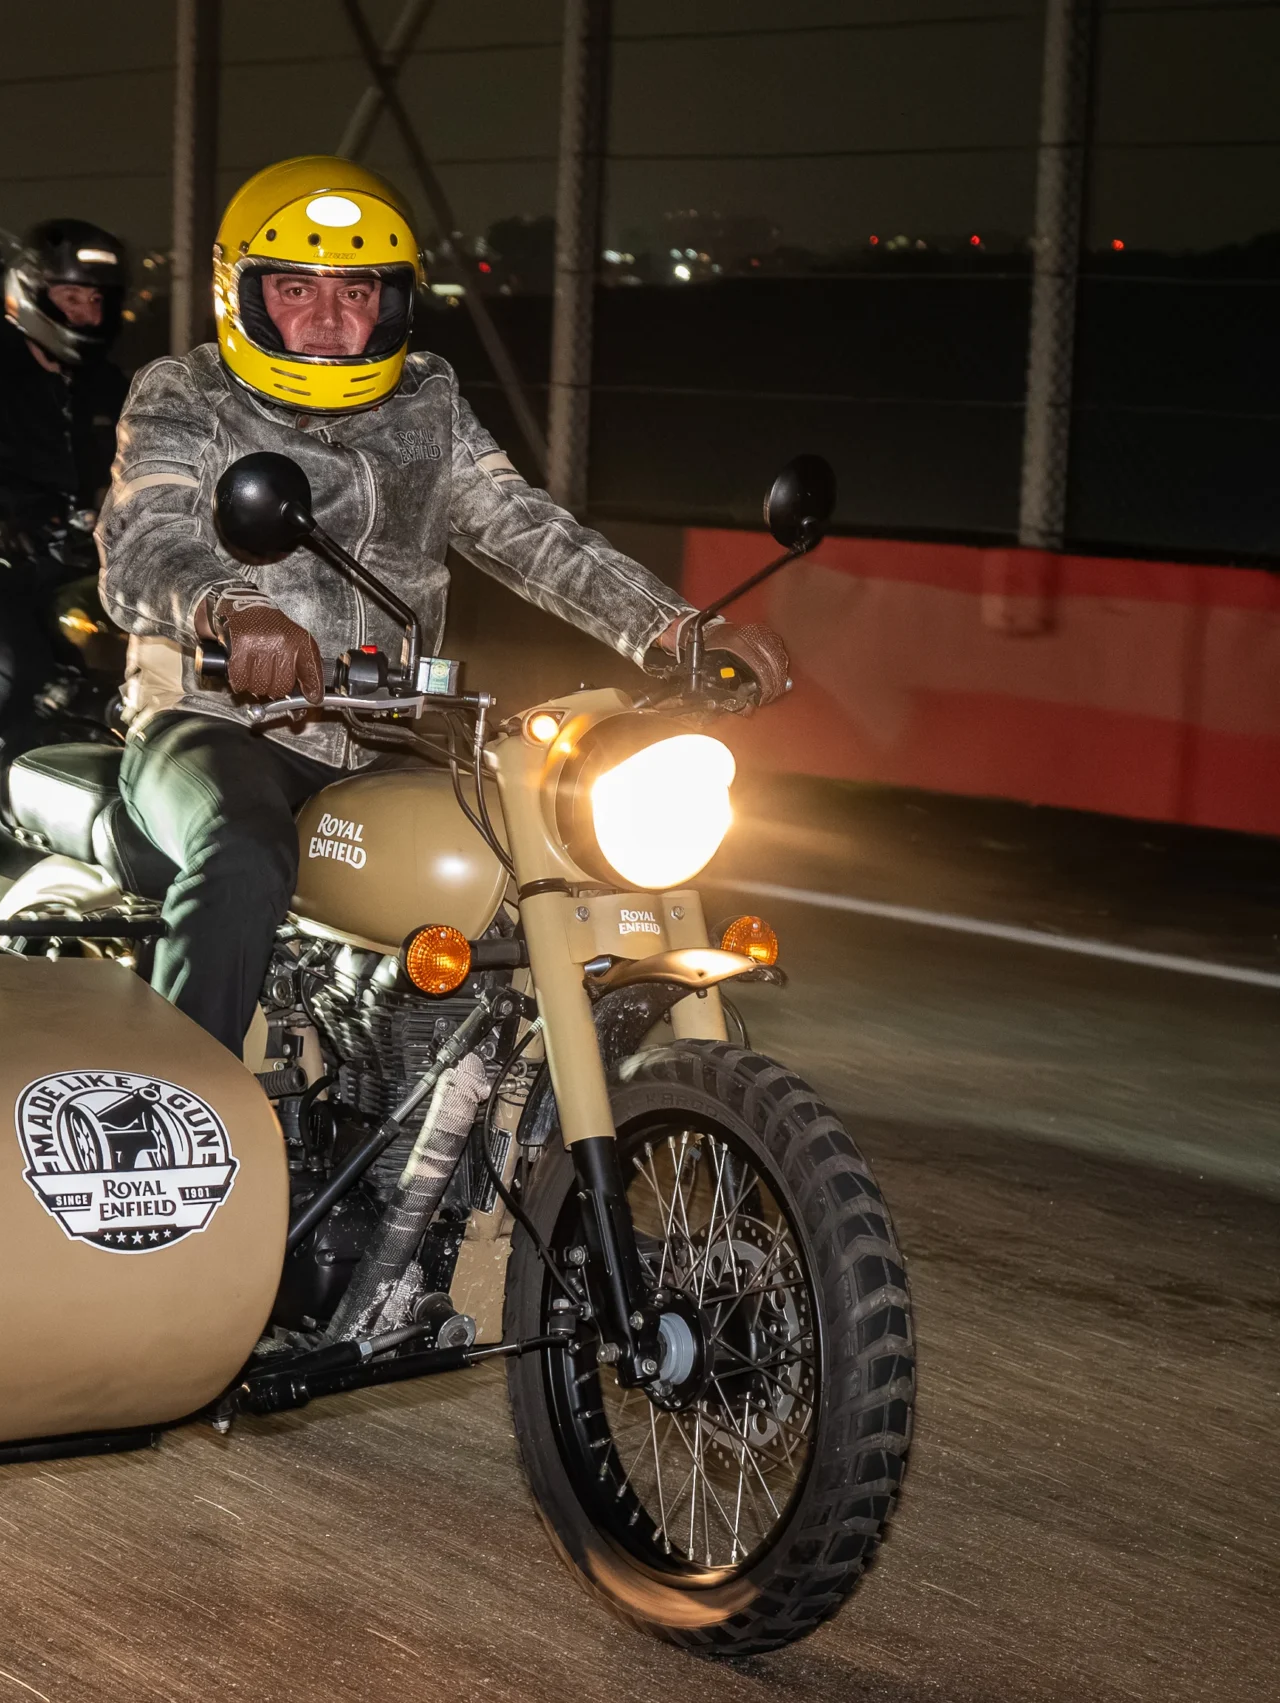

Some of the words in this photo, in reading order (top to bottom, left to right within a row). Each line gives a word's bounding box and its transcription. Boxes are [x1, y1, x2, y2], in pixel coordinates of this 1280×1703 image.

[396, 428, 434, 447] ROYAL
[400, 444, 442, 465] ENFIELD
[317, 813, 364, 842] ROYAL
[308, 837, 367, 869] ENFIELD
[620, 909, 656, 922] ROYAL
[618, 922, 660, 935] ENFIELD
[27, 1085, 66, 1158] MADE
[58, 1074, 134, 1092] LIKE
[166, 1093, 220, 1148] GUN
[102, 1179, 167, 1199] ROYAL
[184, 1187, 210, 1199] 1901
[55, 1194, 88, 1207] SINCE
[99, 1199, 177, 1222] ENFIELD
